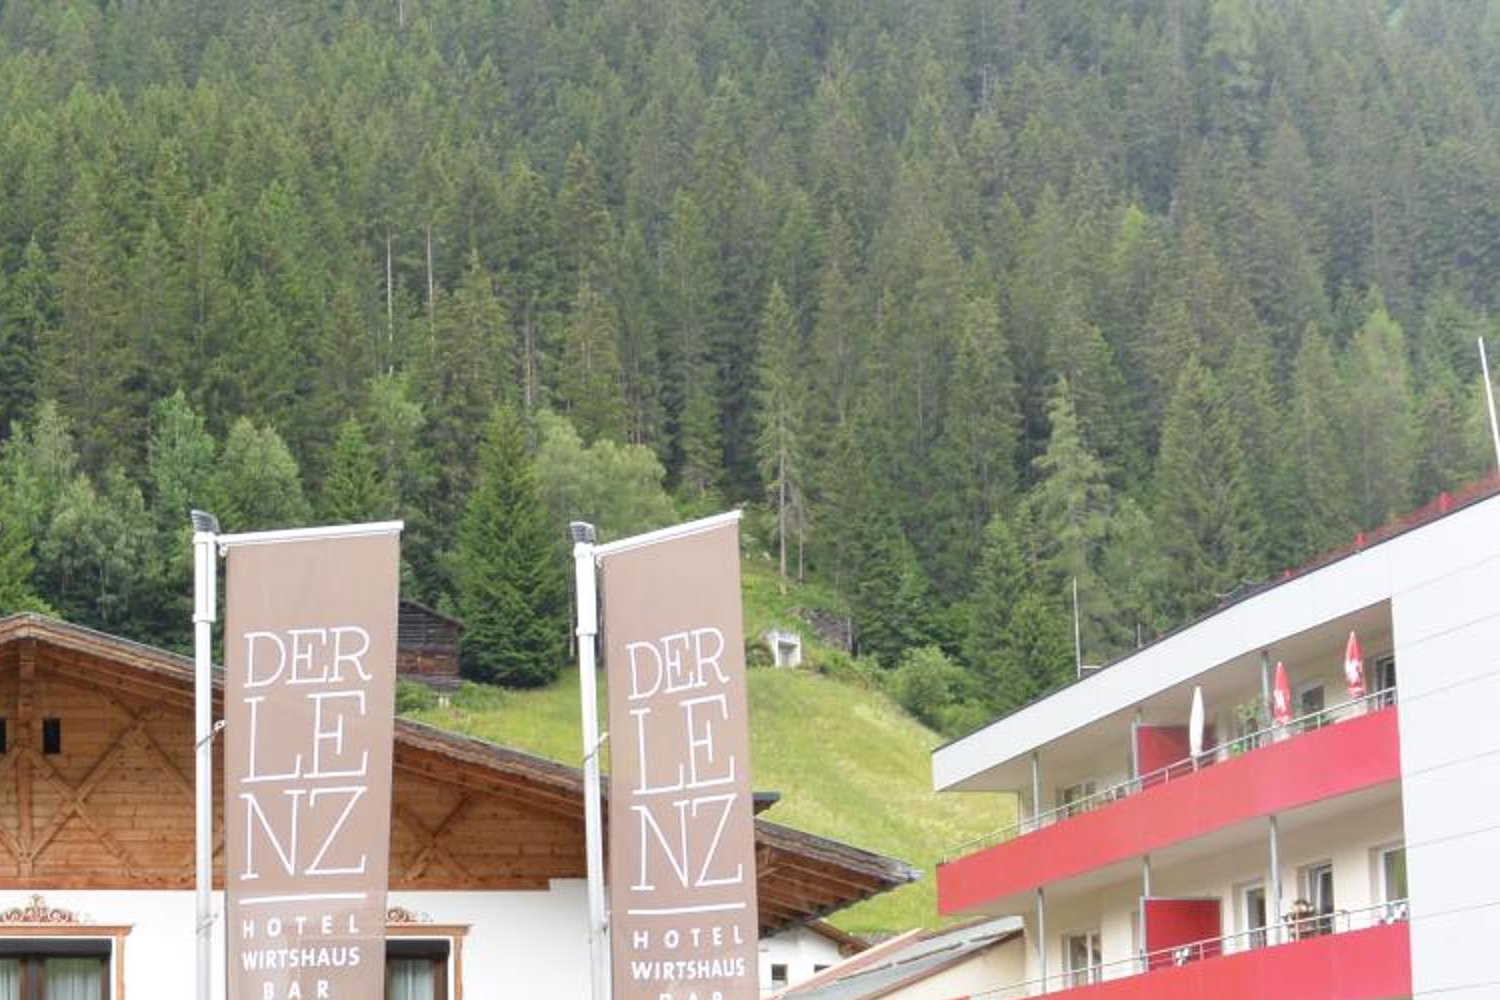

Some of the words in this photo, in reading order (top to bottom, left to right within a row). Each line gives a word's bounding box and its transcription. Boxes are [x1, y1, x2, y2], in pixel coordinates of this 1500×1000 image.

[243, 626, 373, 688] DER
[625, 627, 730, 700] DER
[243, 914, 360, 940] HOTEL
[632, 924, 745, 950] HOTEL
[242, 947, 361, 972] WIRTSHAUS
[631, 957, 746, 981] WIRTSHAUS
